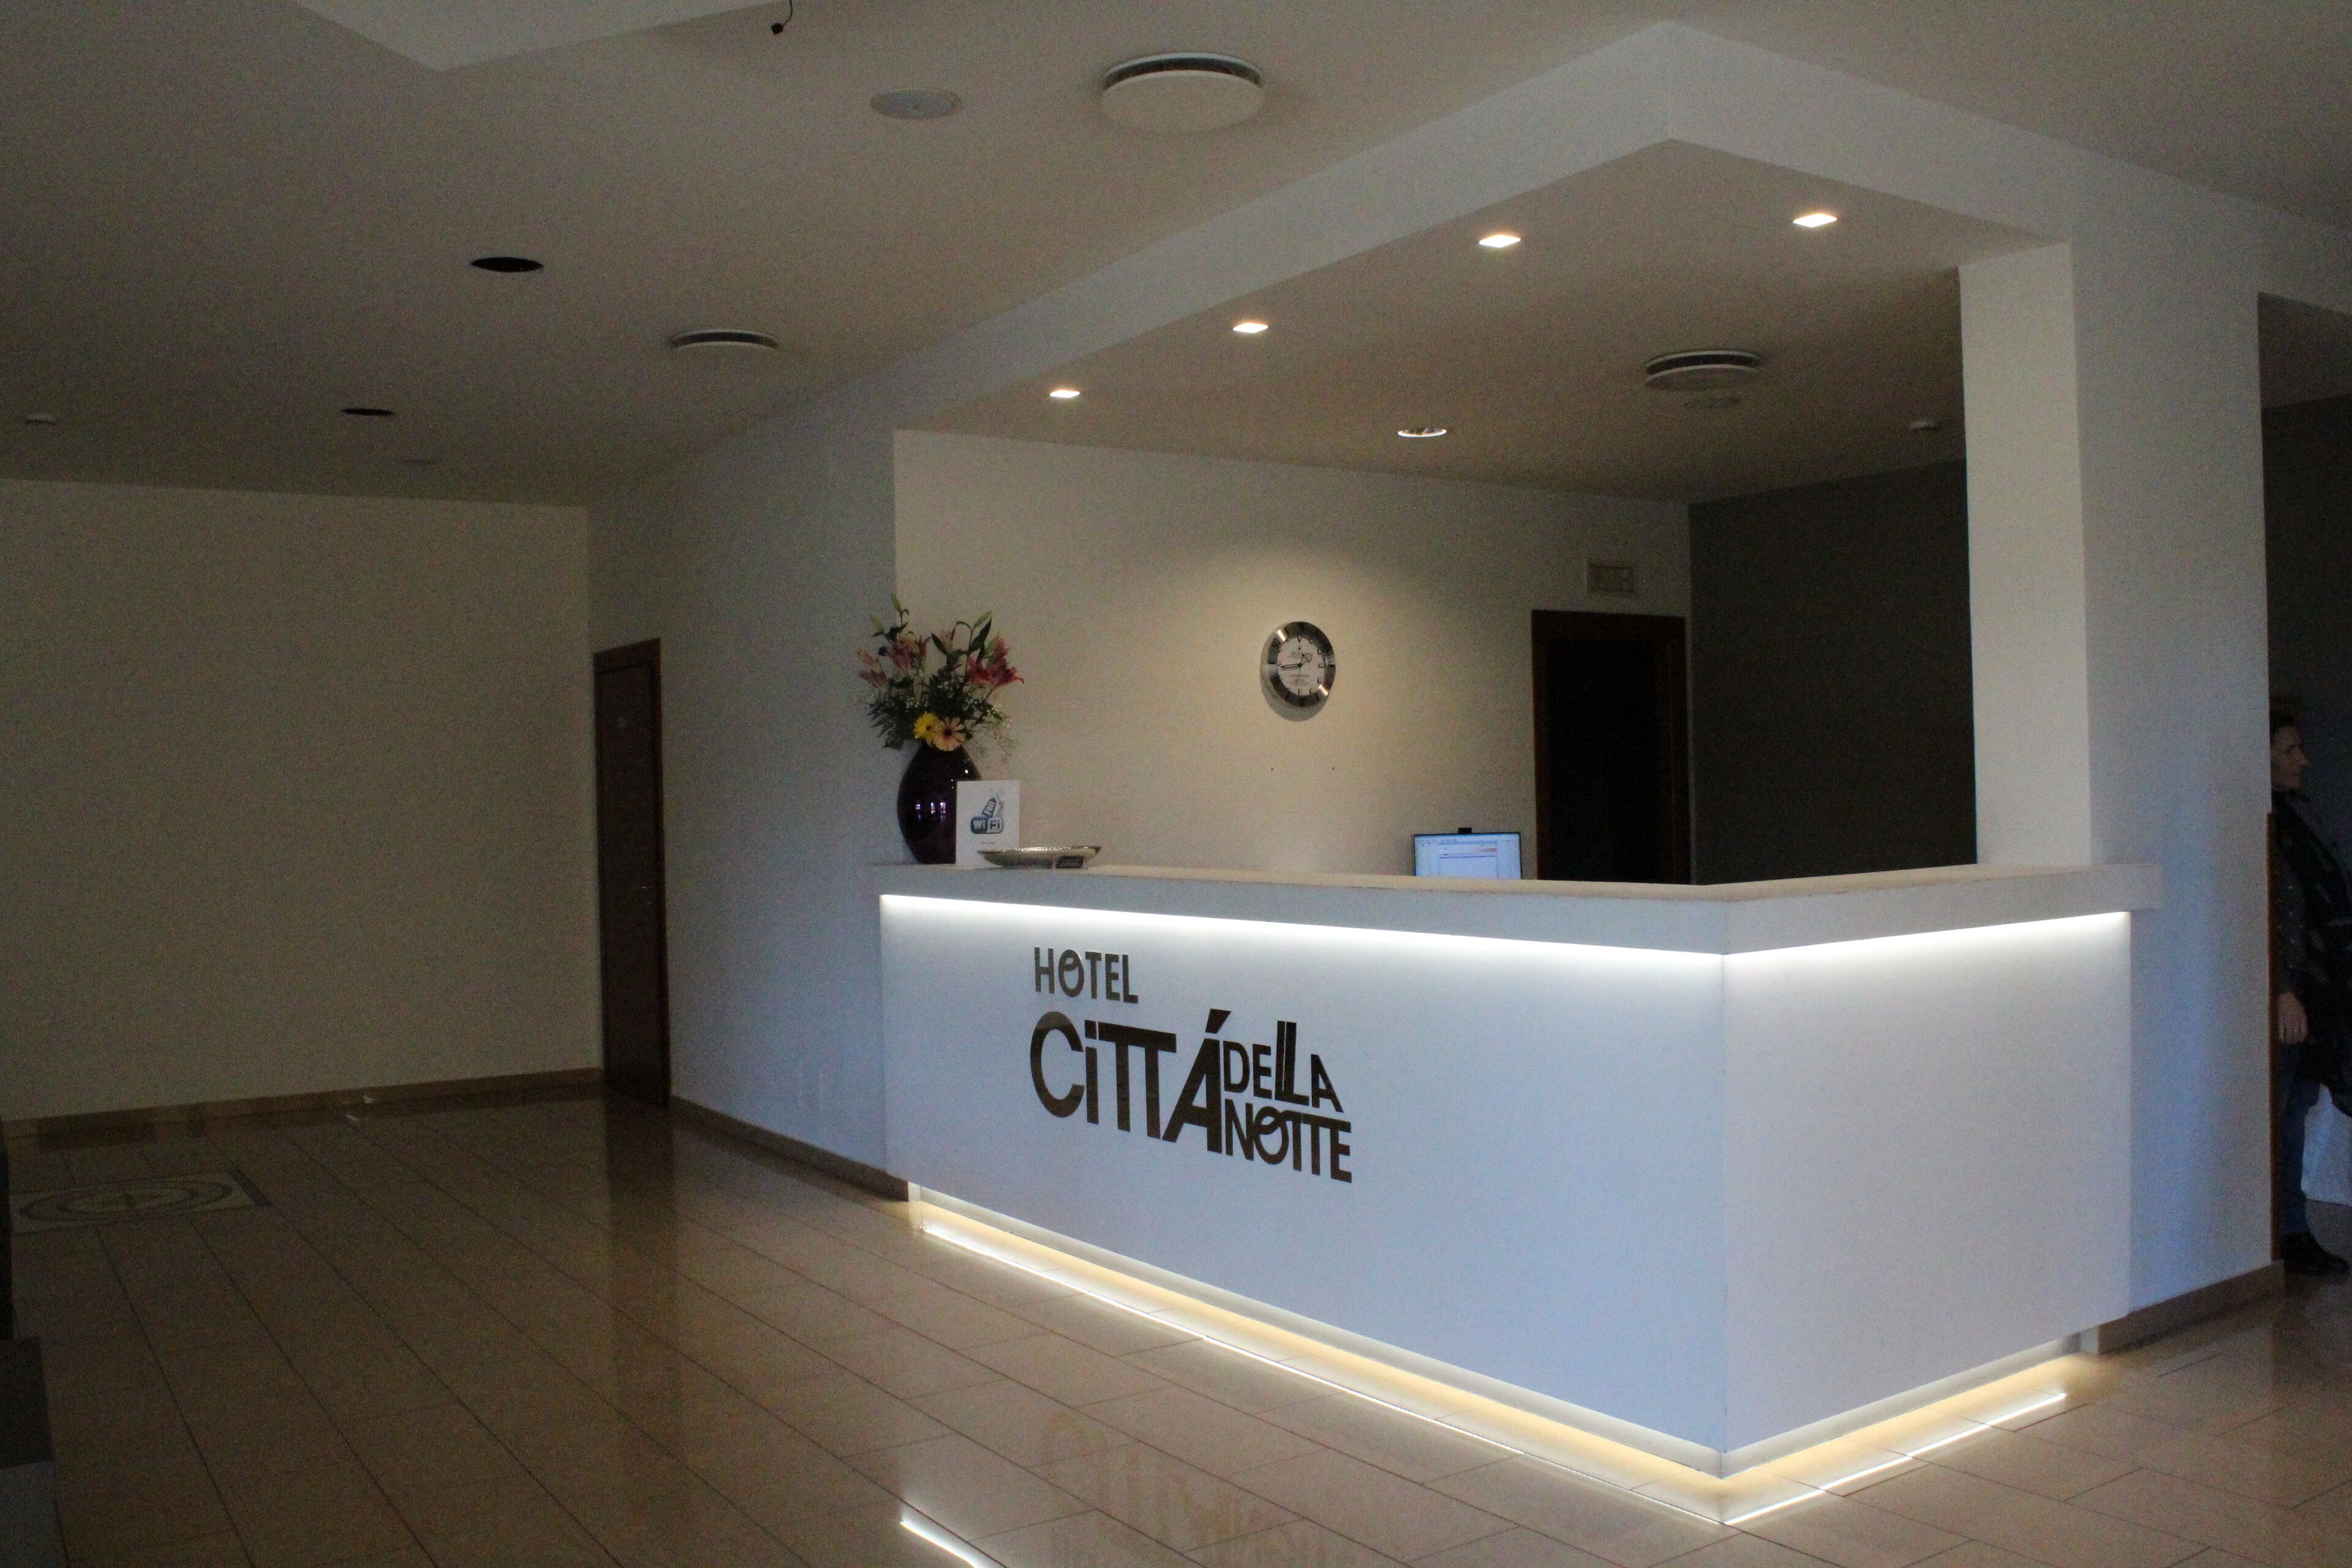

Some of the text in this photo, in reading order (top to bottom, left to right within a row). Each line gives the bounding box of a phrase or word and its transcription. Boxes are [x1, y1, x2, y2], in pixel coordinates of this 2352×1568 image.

[1035, 947, 1138, 1004] HOTEL
[1223, 1020, 1344, 1113] DELLA
[1224, 1098, 1352, 1183] NOTTE
